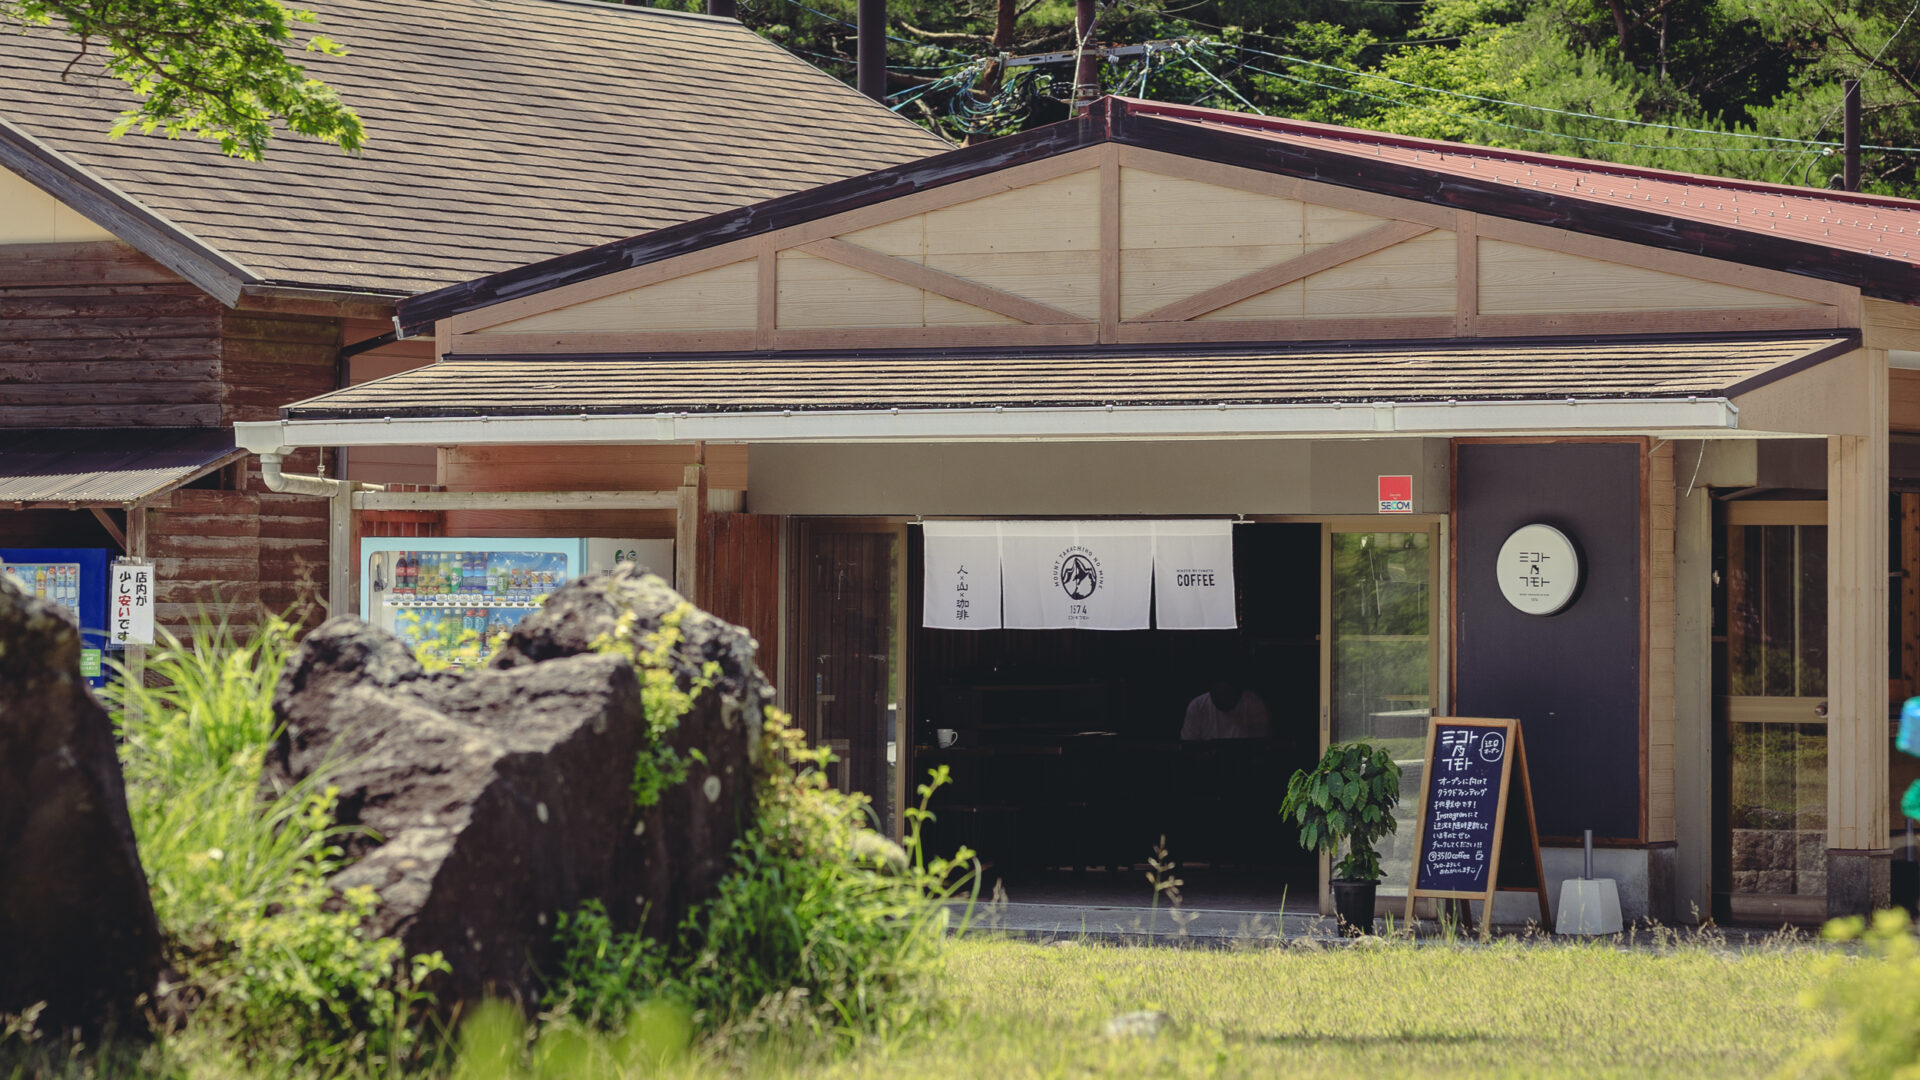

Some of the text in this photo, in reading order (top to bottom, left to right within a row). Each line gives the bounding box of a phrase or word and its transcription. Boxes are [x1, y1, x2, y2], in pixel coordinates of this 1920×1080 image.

[1381, 501, 1410, 510] SECOM
[1519, 552, 1551, 562] ミコト
[1177, 574, 1215, 586] COFFEE
[1519, 577, 1551, 587] フモト
[135, 572, 147, 607] 店内が
[118, 571, 131, 642] 少し安いです
[1070, 605, 1087, 614] 1574
[1442, 730, 1479, 744] ミコト
[1441, 757, 1473, 771] フモト
[1438, 776, 1488, 785] オープンに向けて
